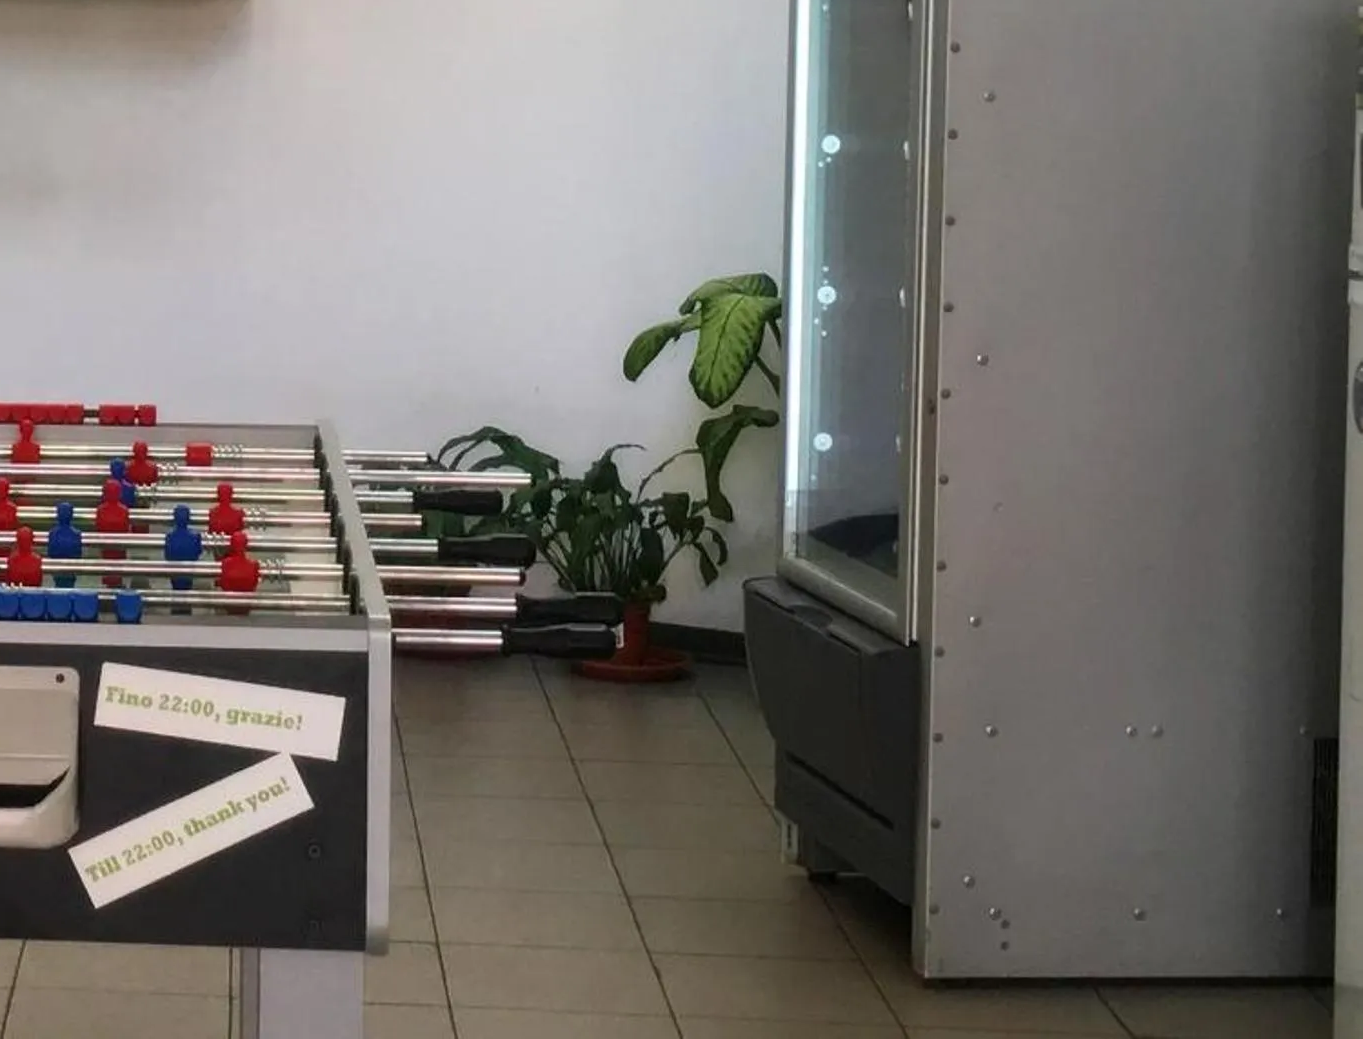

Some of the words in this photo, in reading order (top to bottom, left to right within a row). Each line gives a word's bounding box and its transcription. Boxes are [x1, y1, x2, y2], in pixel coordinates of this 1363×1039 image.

[104, 686, 153, 709] Fino
[158, 693, 221, 723] 22:00,
[84, 862, 122, 882] Till
[122, 830, 184, 865] 22:00,
[182, 800, 245, 836] thank
[244, 776, 291, 812] you!
